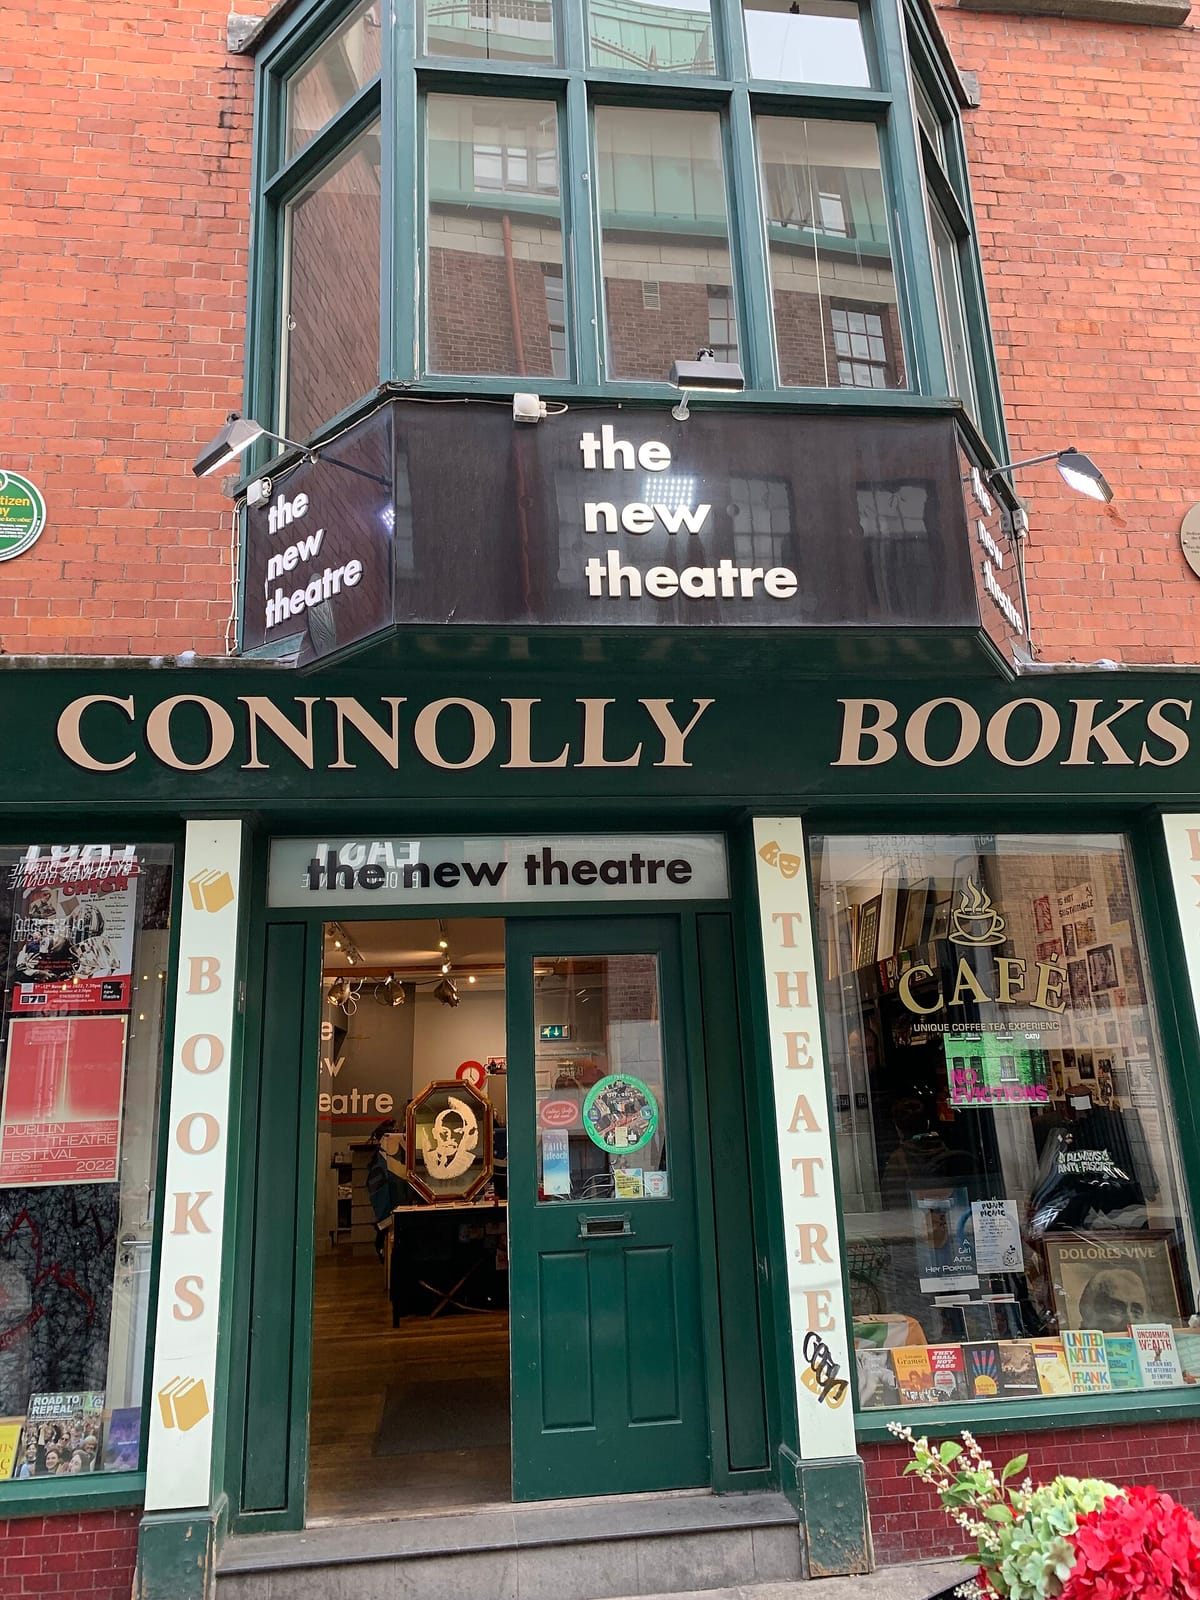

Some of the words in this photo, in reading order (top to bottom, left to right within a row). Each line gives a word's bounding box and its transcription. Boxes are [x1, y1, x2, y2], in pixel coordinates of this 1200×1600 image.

[580, 424, 671, 471] the
[268, 493, 309, 534] the
[584, 502, 712, 534] new
[268, 528, 326, 581] new
[585, 549, 798, 599] theatre
[265, 559, 363, 629] theatre
[56, 693, 716, 772] CONNOLLY
[829, 696, 1193, 768] BOOKS
[307, 850, 386, 891] the
[403, 861, 508, 889] new
[524, 847, 693, 886] theatre
[898, 952, 1069, 1015] CAFÉ
[913, 1023, 950, 1032] UNIQUE
[952, 1023, 987, 1032] COFFEE
[988, 1022, 1007, 1031] TEA
[950, 1068, 977, 1085] NO
[952, 1085, 1048, 1103] EVICTIONS
[4, 1123, 66, 1136] DUBLIN
[771, 911, 837, 1333] THEATRE
[50, 1133, 116, 1147] THEATRE
[170, 955, 225, 1322] BOOKS
[2, 1148, 77, 1162] FESTIVAL
[1066, 1150, 1102, 1162] ALWAYS
[76, 1160, 115, 1172] 2022
[980, 1209, 1006, 1217] PICNIC
[981, 1201, 1005, 1210] PUNK
[953, 1255, 972, 1263] And
[1059, 1247, 1121, 1260] DOLORES
[1124, 1247, 1156, 1259] VIVE
[1066, 1332, 1103, 1347] UNITED
[1138, 1339, 1173, 1351] WEALTH
[1068, 1347, 1106, 1363] NATION
[1071, 1371, 1109, 1384] FRANK
[33, 1395, 63, 1406] ROAD
[65, 1394, 80, 1404] TO
[32, 1404, 73, 1415] REPEAL
